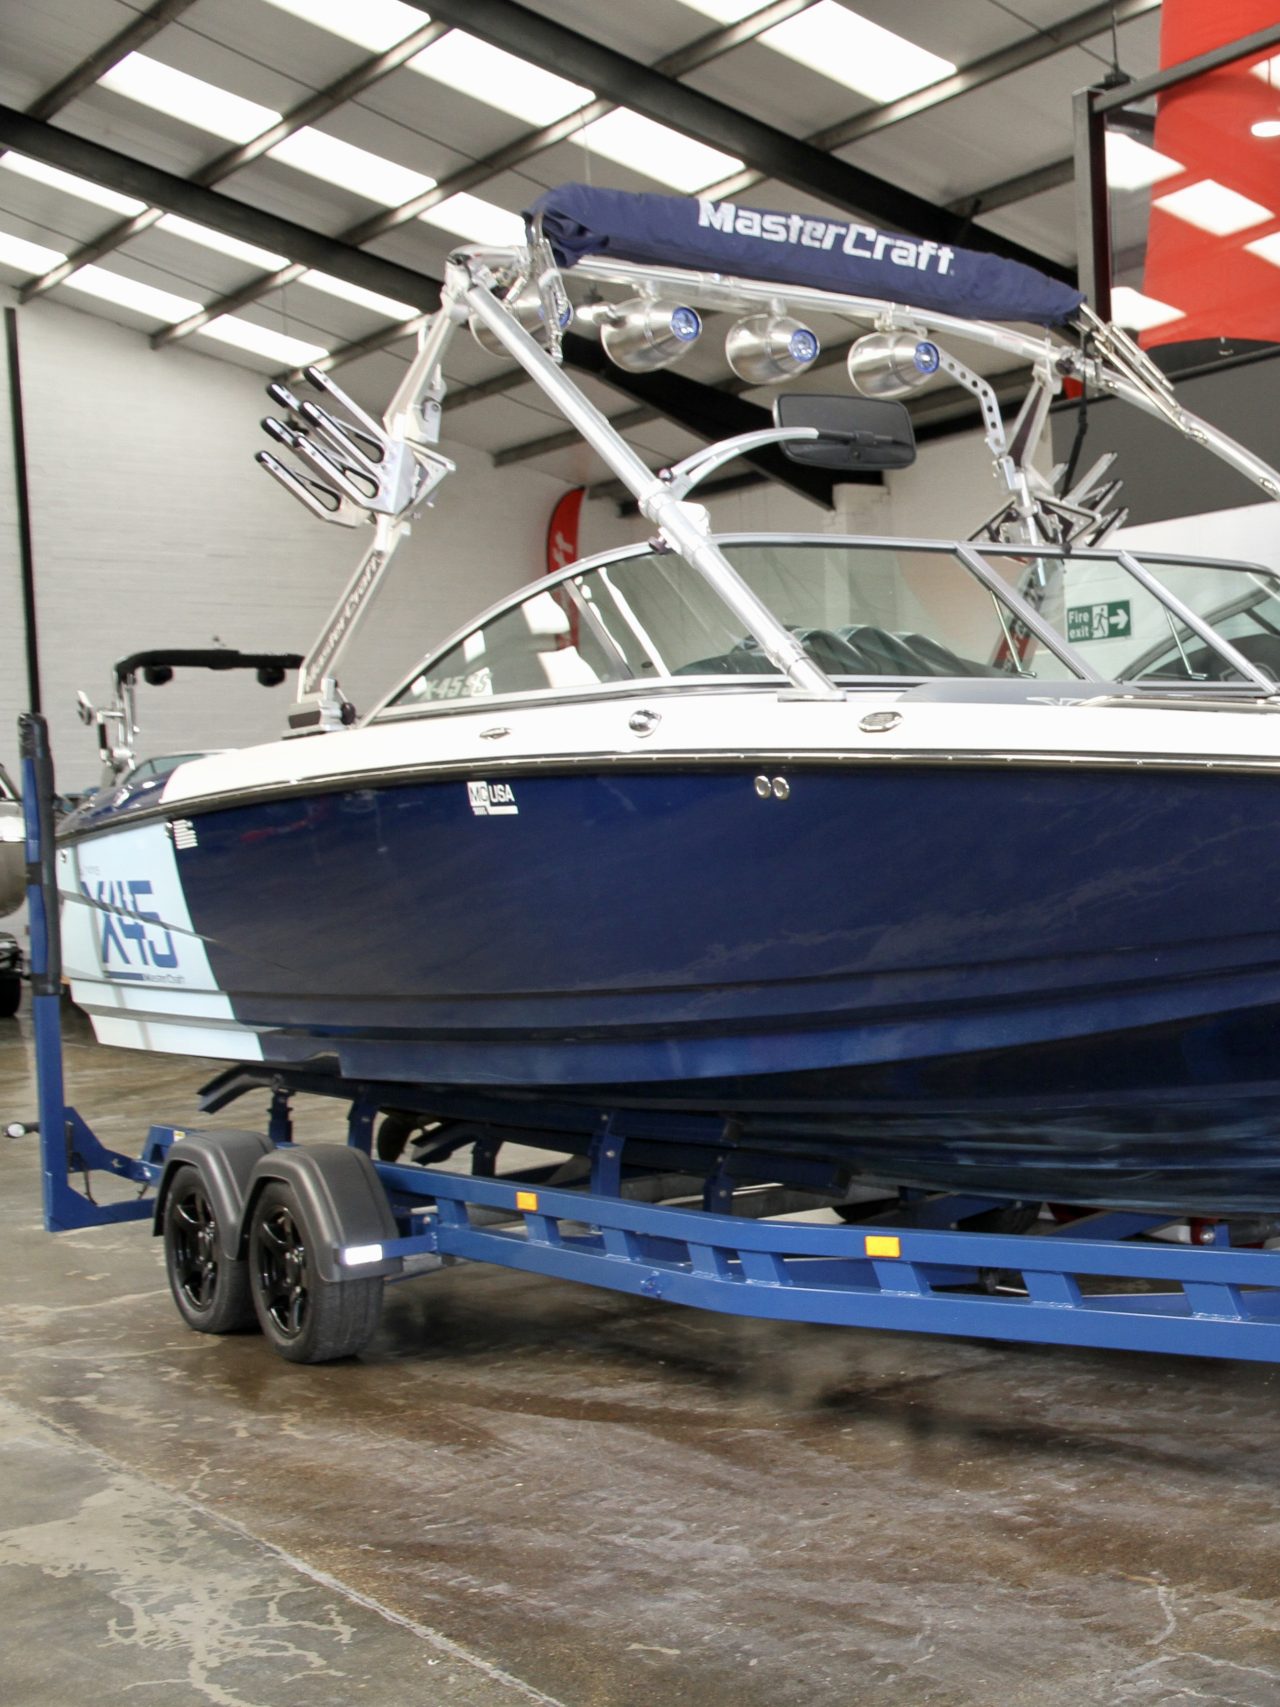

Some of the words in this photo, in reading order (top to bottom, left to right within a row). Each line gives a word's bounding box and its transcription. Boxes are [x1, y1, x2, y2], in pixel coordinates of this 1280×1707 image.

[698, 198, 955, 276] MasterCraft
[1068, 611, 1090, 624] Fire
[1069, 627, 1090, 639] exit
[488, 784, 516, 802] USA
[80, 880, 178, 968] X45
